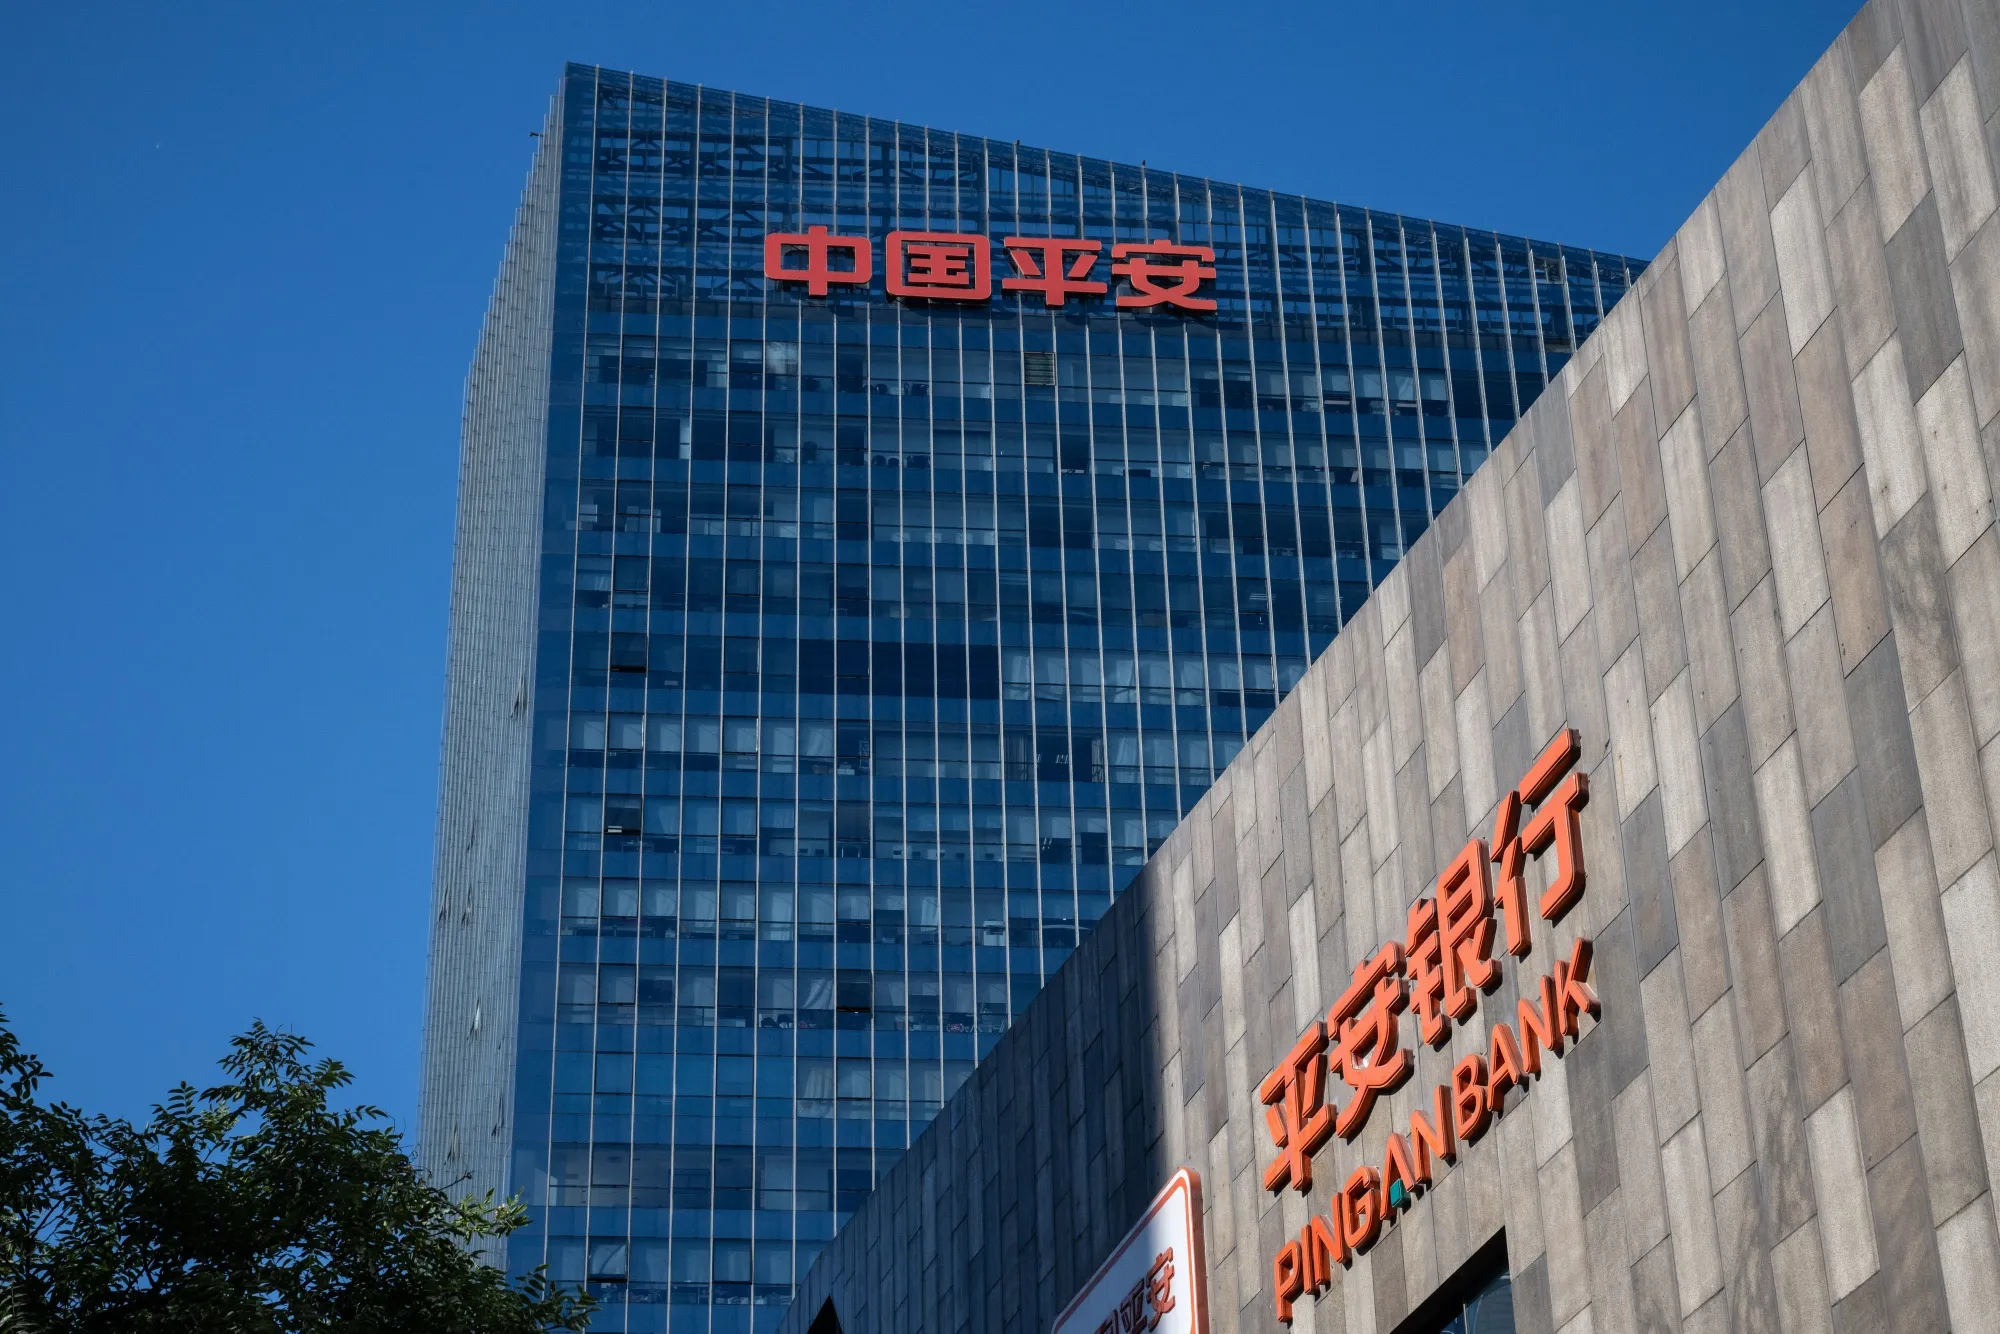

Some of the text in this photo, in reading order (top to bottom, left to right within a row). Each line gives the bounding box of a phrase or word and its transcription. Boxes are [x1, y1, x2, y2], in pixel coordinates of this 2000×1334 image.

[764, 226, 1218, 311] 中国平安
[1260, 728, 1588, 1192] 平安银行
